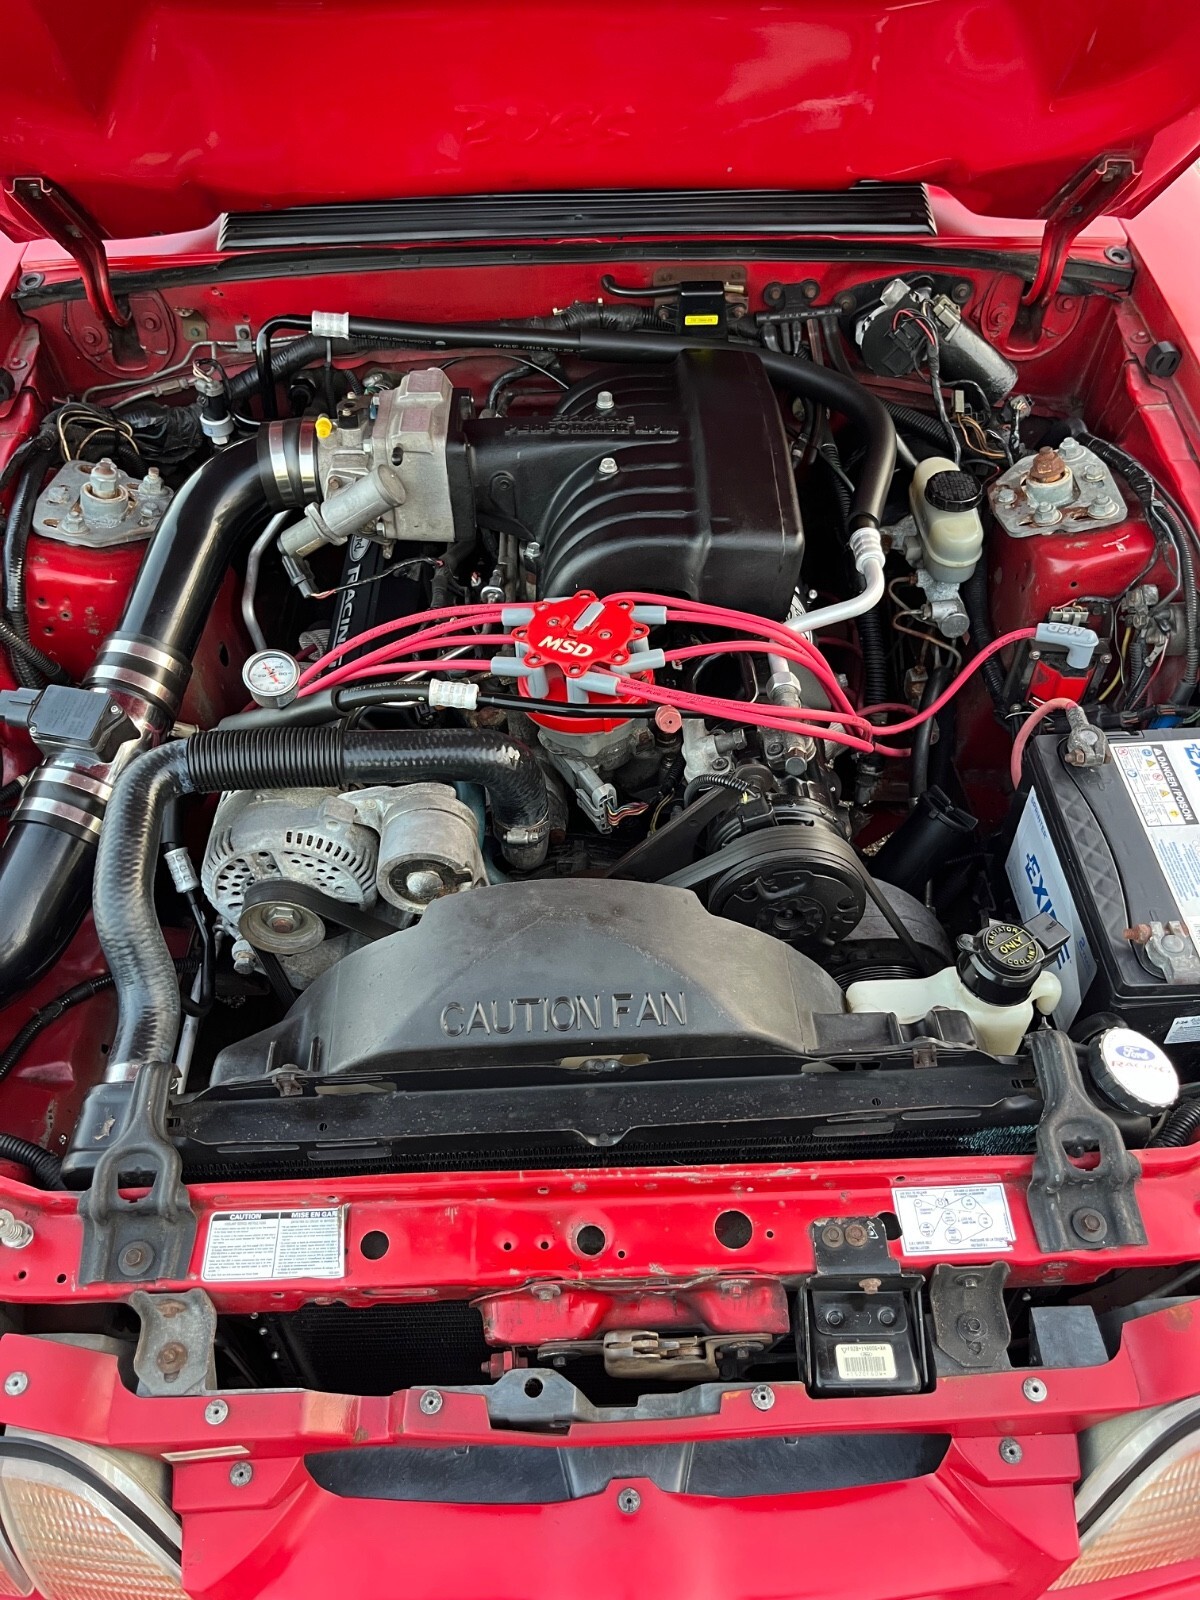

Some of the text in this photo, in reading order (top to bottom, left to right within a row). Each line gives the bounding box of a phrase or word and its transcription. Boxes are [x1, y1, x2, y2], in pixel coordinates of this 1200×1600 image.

[1047, 623, 1085, 636] MSD
[538, 636, 593, 657] MSD
[646, 689, 662, 697] PLUG
[1157, 756, 1178, 788] DANGER
[1025, 852, 1071, 970] EXIE
[988, 926, 1018, 945] RADIATOR
[1000, 936, 1023, 954] ONLY
[1007, 946, 1036, 965] COOLANT
[440, 991, 687, 1037] CAUTION FAN
[1122, 1046, 1151, 1060] Ford
[1111, 1060, 1171, 1074] RACING
[291, 1210, 310, 1218] MISE
